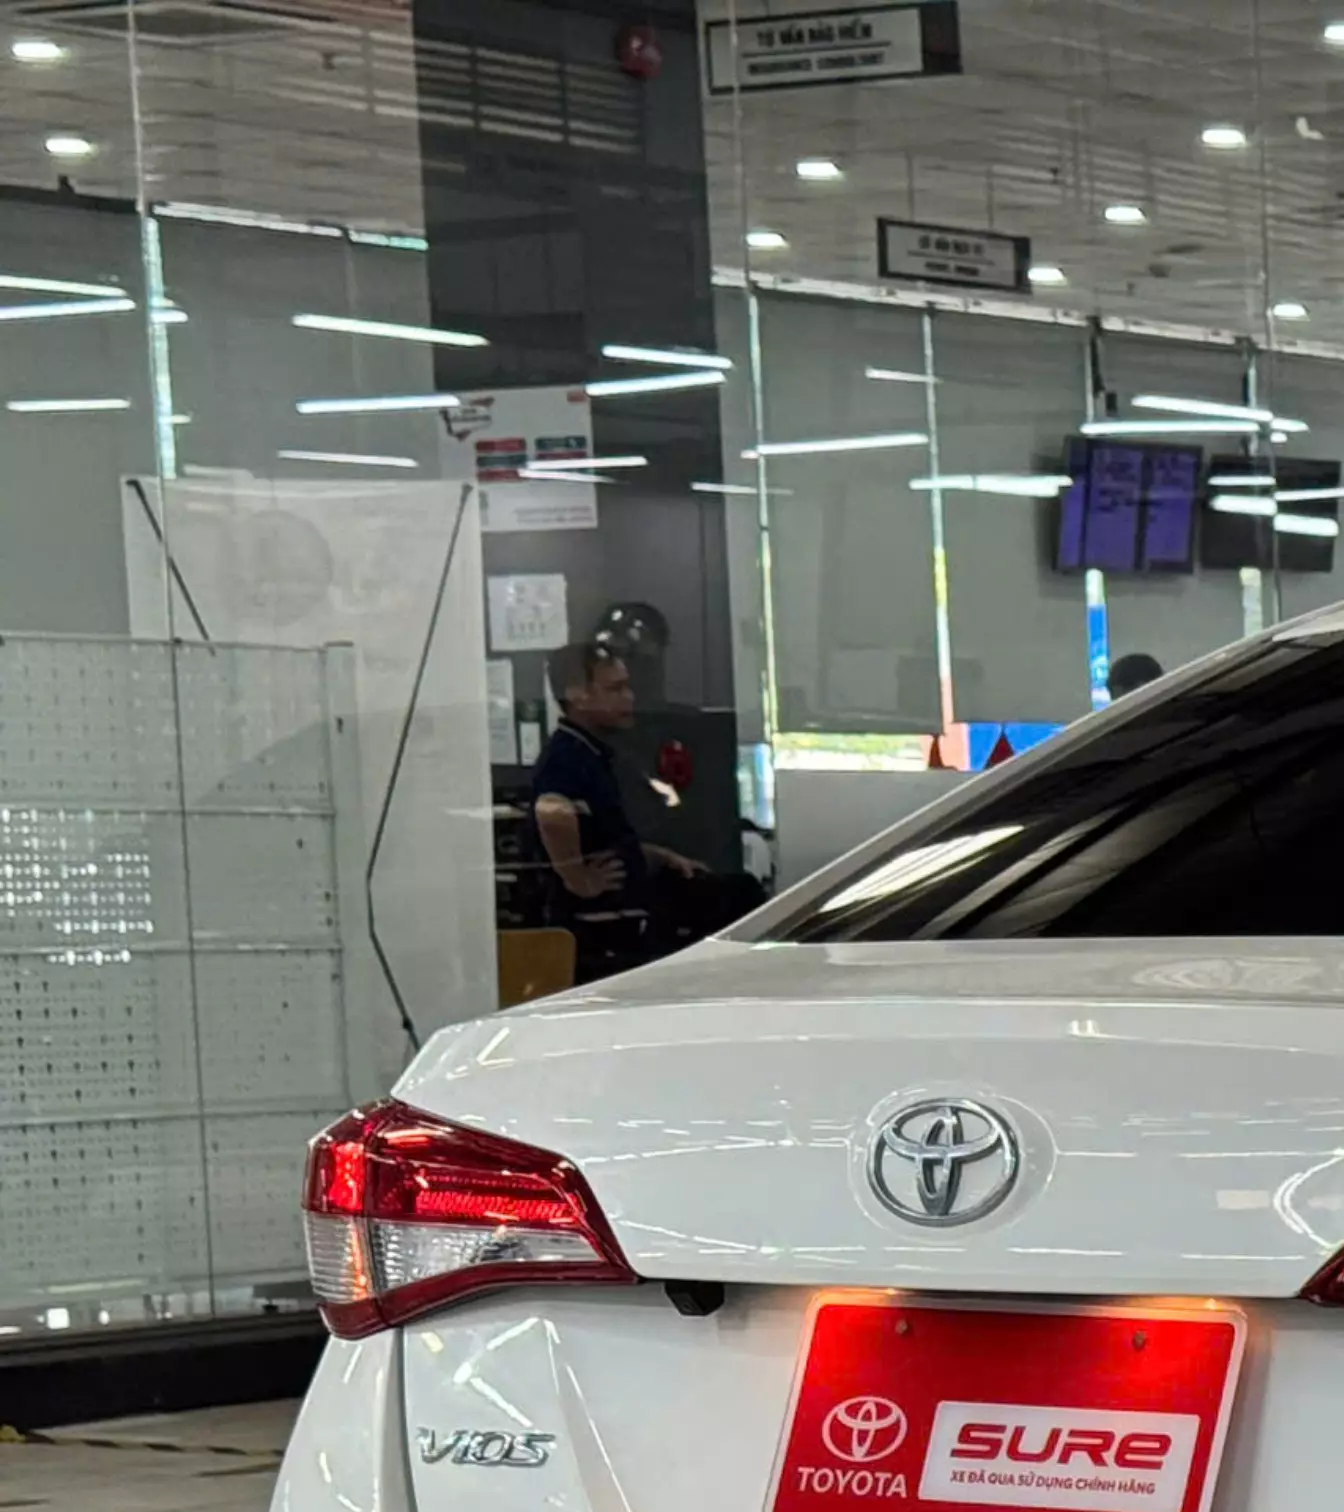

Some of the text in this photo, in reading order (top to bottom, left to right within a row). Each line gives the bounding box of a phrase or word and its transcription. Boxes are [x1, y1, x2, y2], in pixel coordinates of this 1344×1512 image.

[415, 1427, 556, 1467] VIOS
[798, 1466, 908, 1498] TOYOTA
[950, 1470, 966, 1483] XE
[968, 1470, 986, 1484] ĐÃ
[987, 1475, 1015, 1486] QUA
[1018, 1471, 1034, 1486] SỬ
[1036, 1476, 1072, 1491] DỤNG
[1075, 1476, 1116, 1492] CHÍNH
